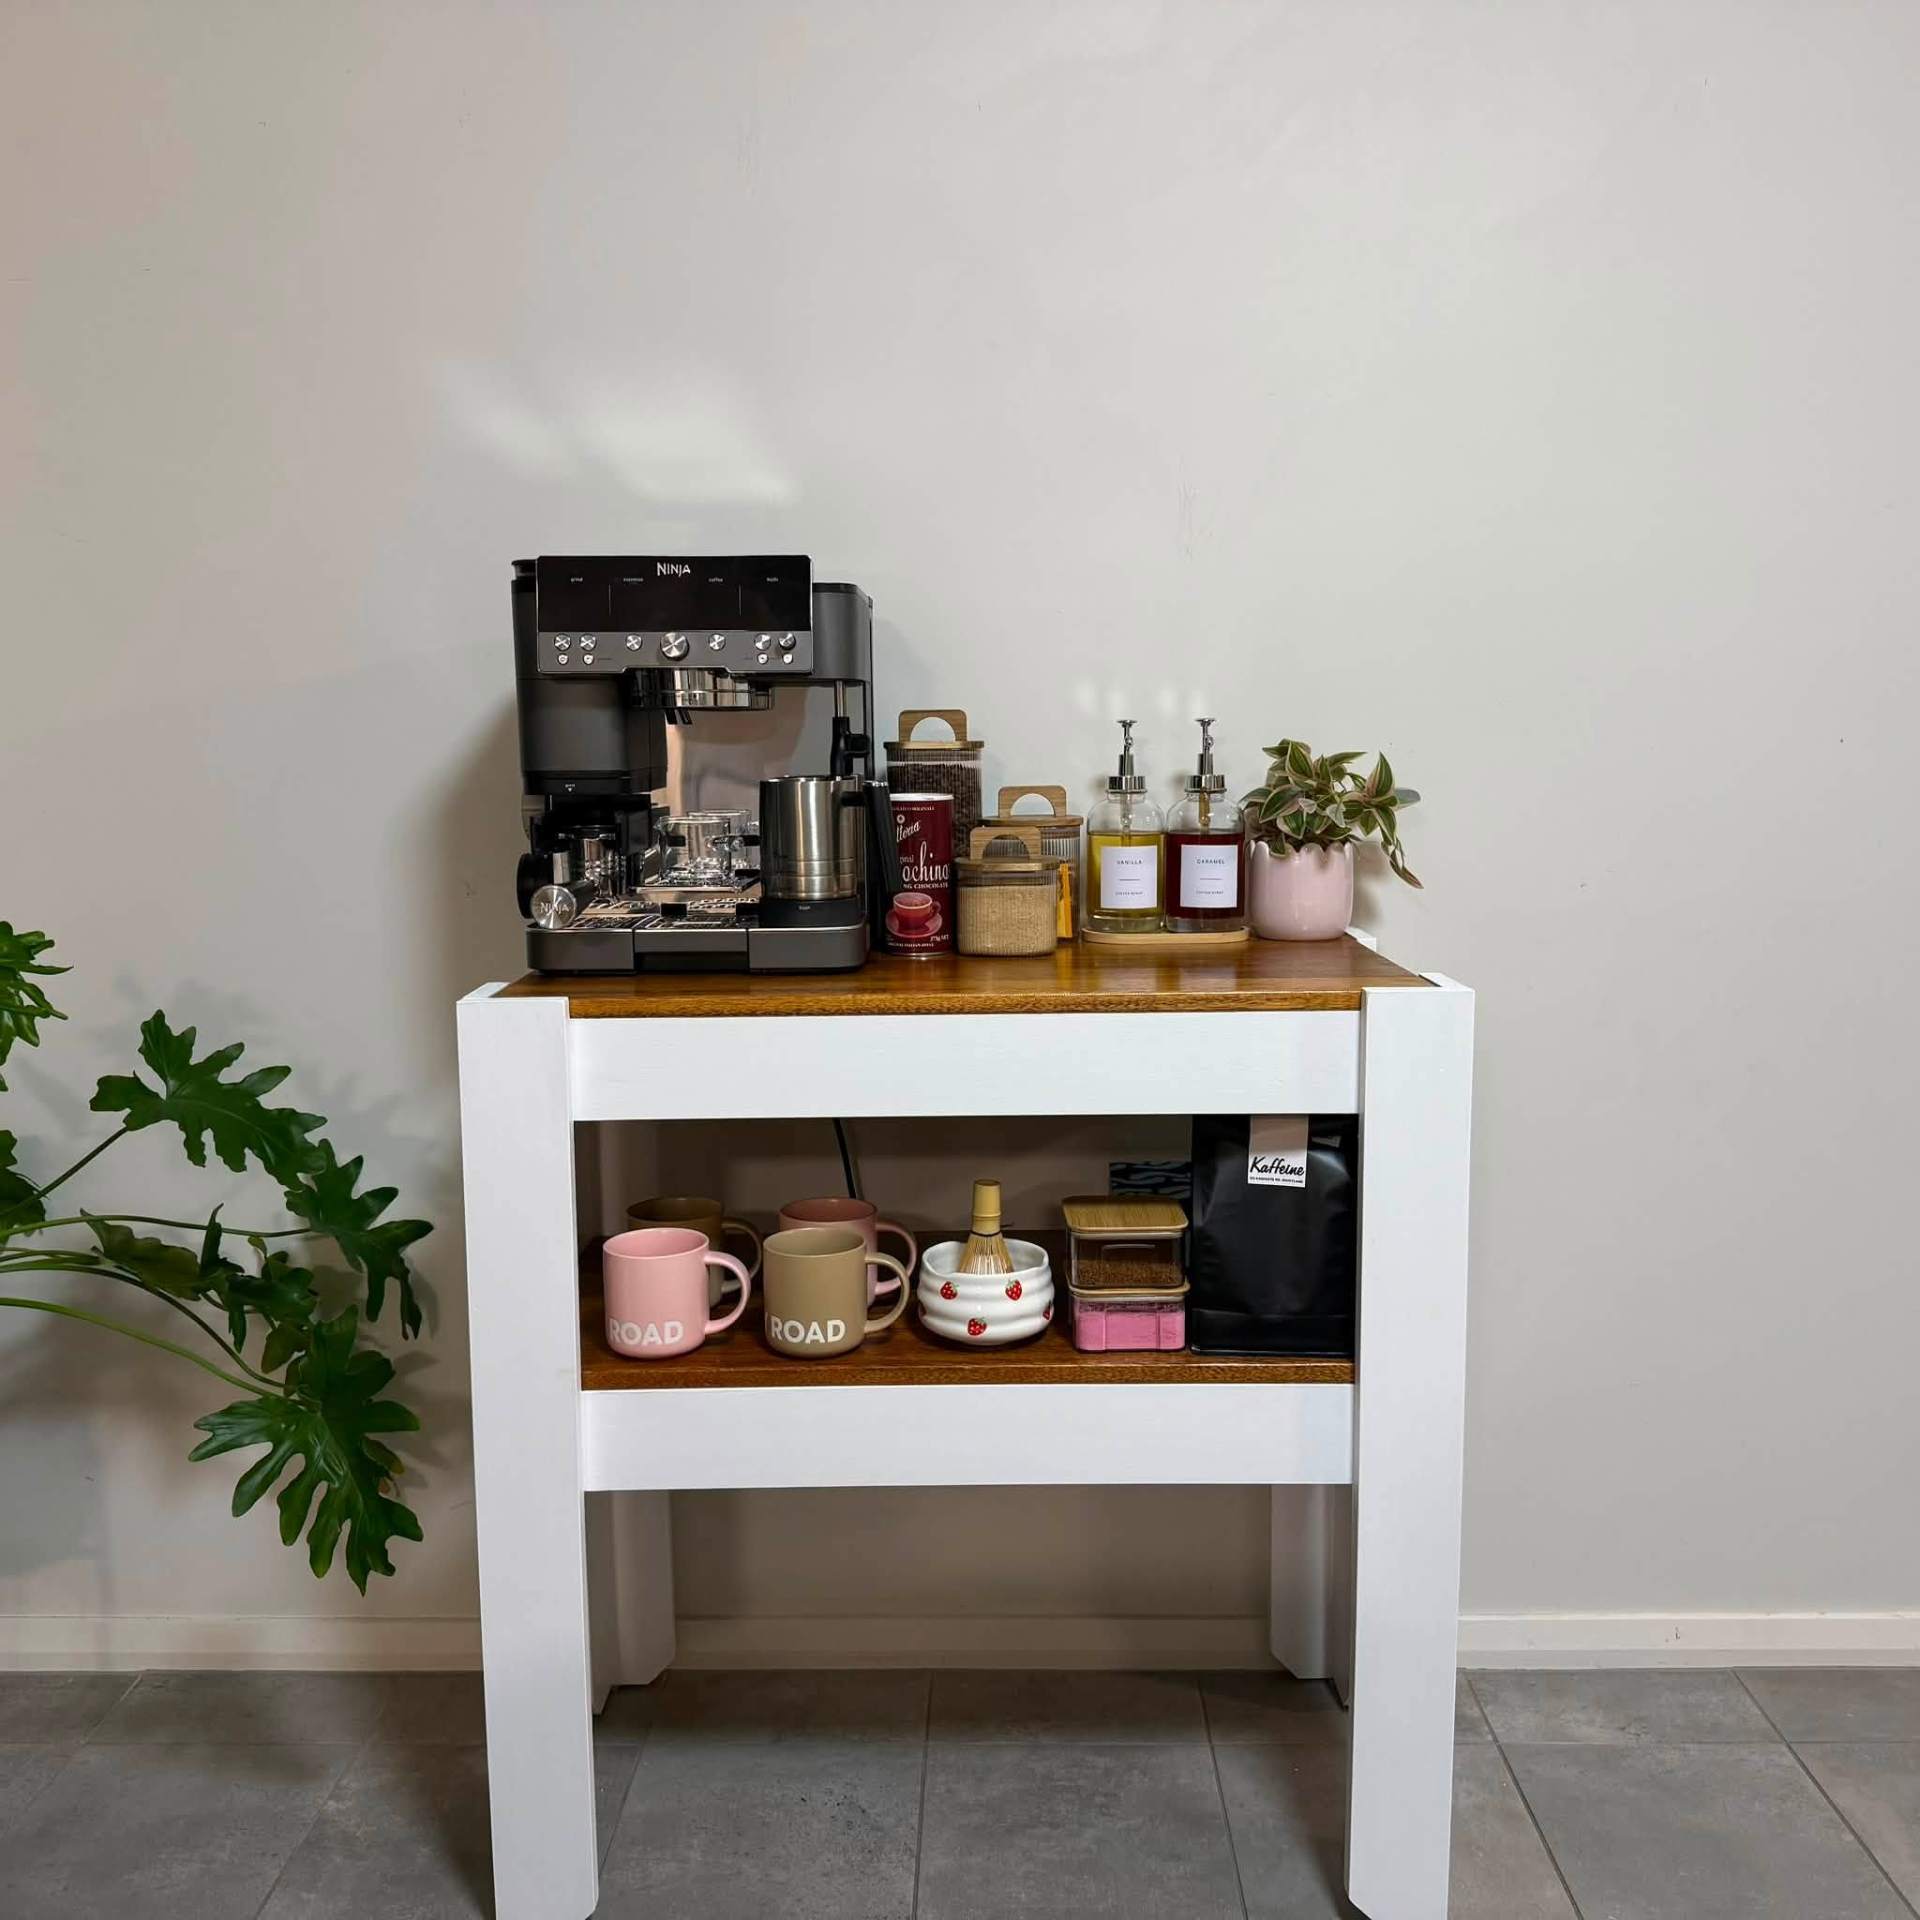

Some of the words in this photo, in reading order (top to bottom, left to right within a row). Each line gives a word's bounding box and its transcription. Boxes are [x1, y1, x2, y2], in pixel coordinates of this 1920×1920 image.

[656, 562, 691, 577] NINJA
[540, 902, 569, 914] NINJA
[1250, 1156, 1304, 1176] Kaffeine
[608, 1317, 684, 1345] ROAD
[770, 1314, 846, 1345] ROAD
